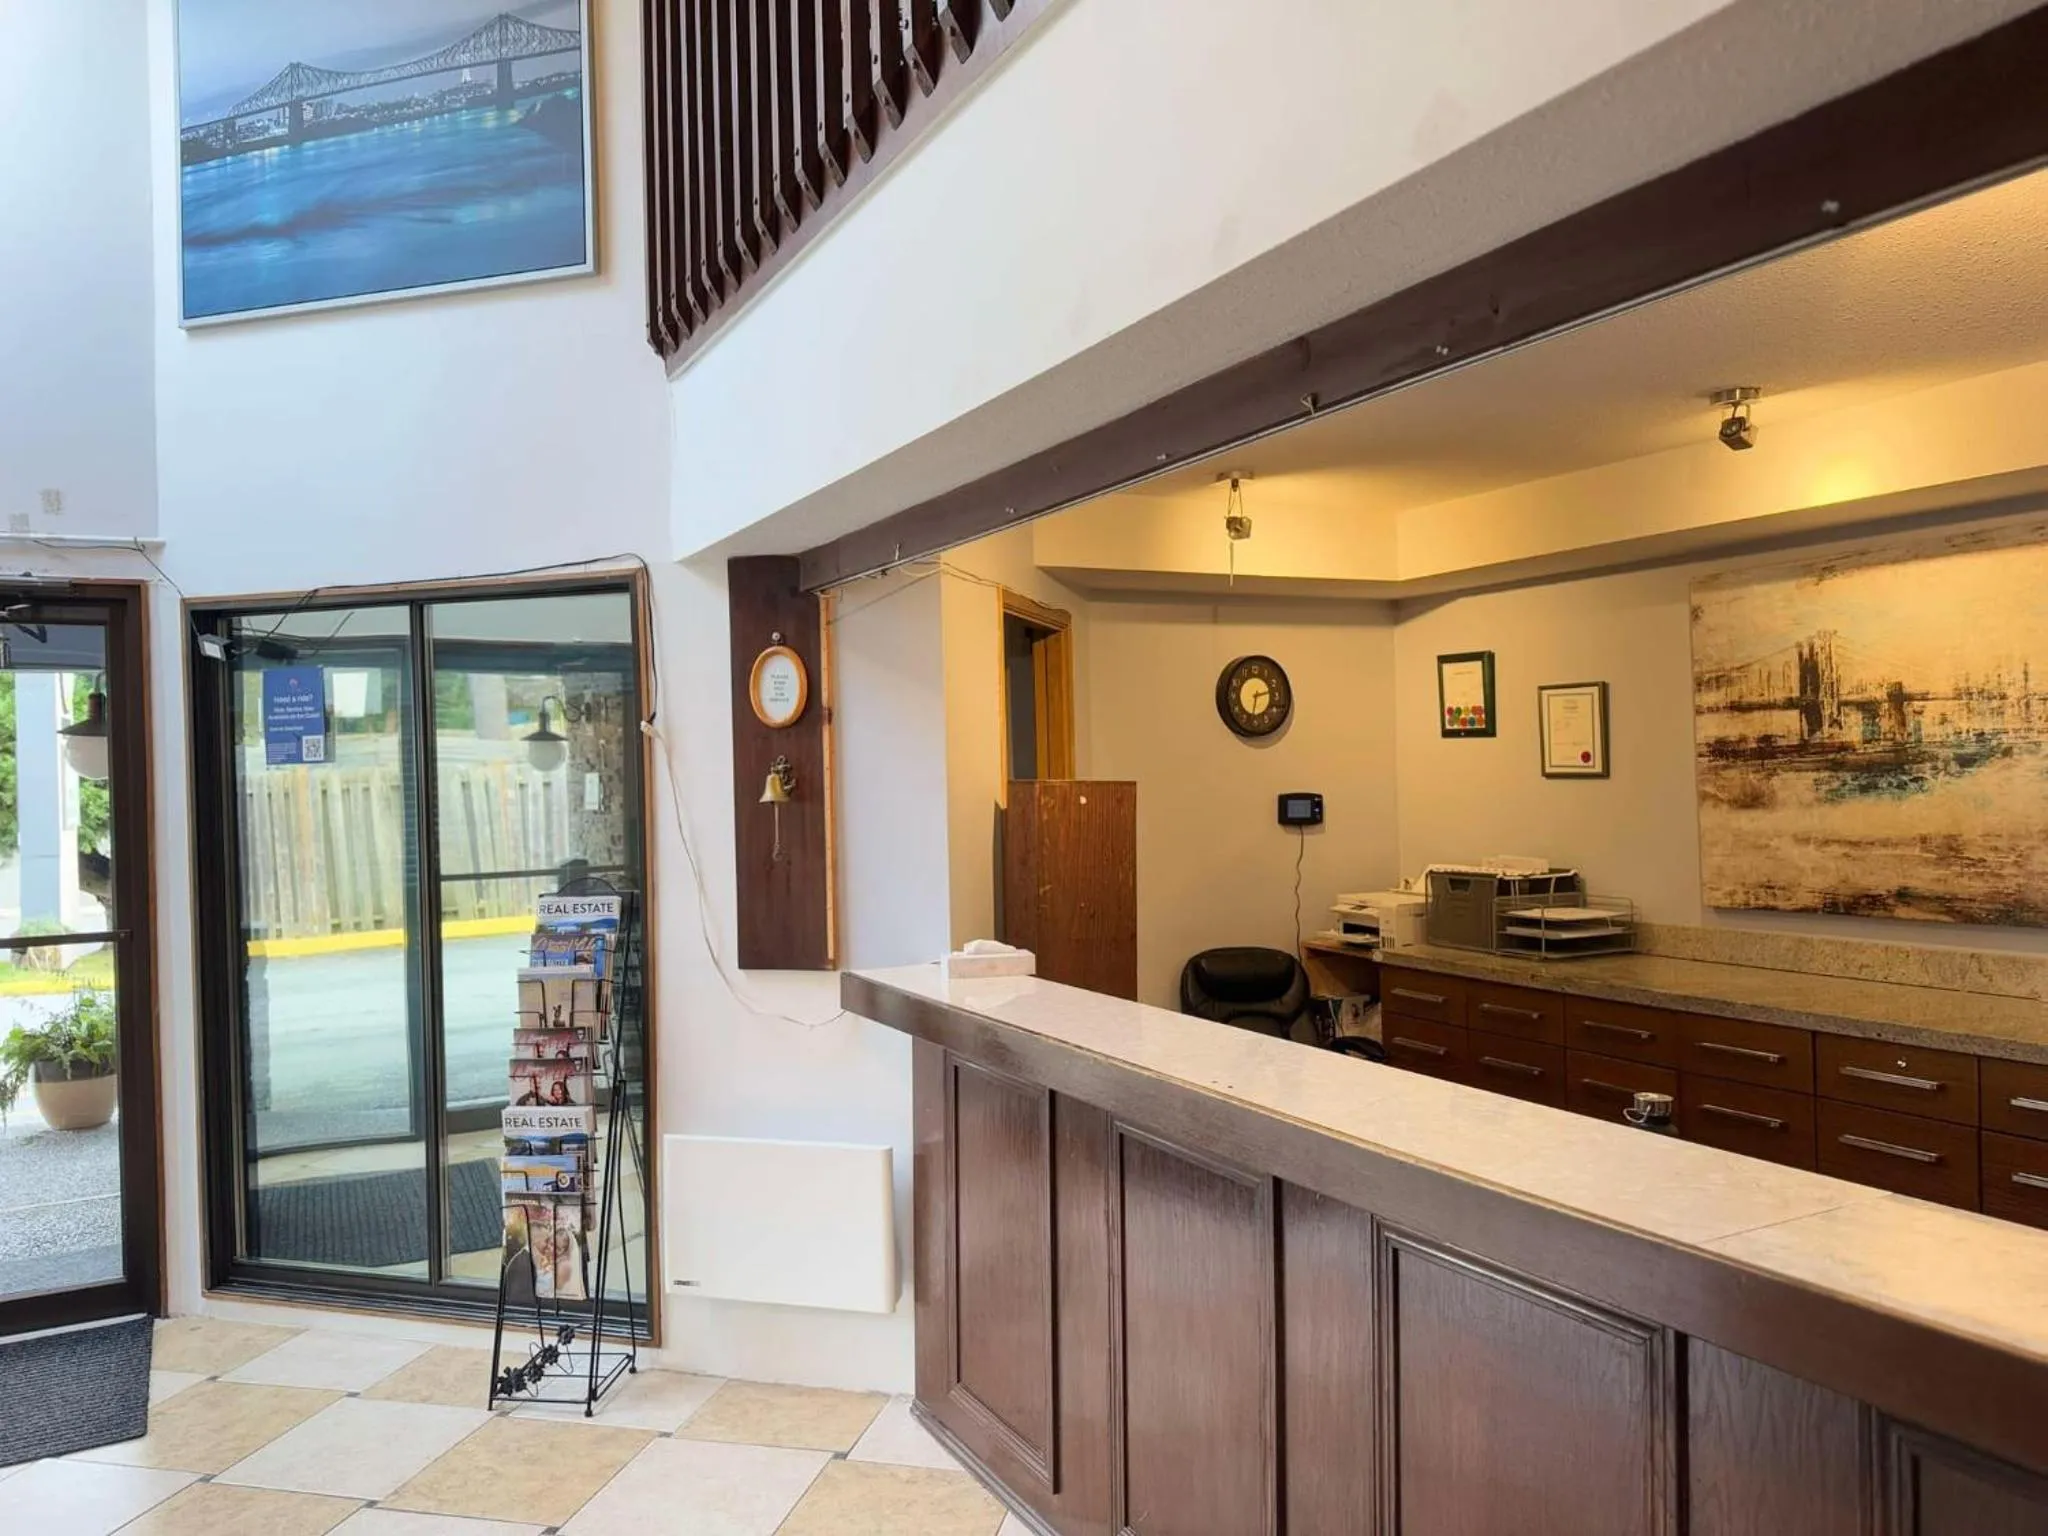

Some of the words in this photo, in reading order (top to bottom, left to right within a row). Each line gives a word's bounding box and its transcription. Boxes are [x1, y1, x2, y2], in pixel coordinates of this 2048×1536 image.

[538, 903, 569, 915] REAL
[572, 902, 614, 914] ESTATE
[504, 1117, 536, 1127] REAL
[538, 1117, 582, 1128] ESTATE
